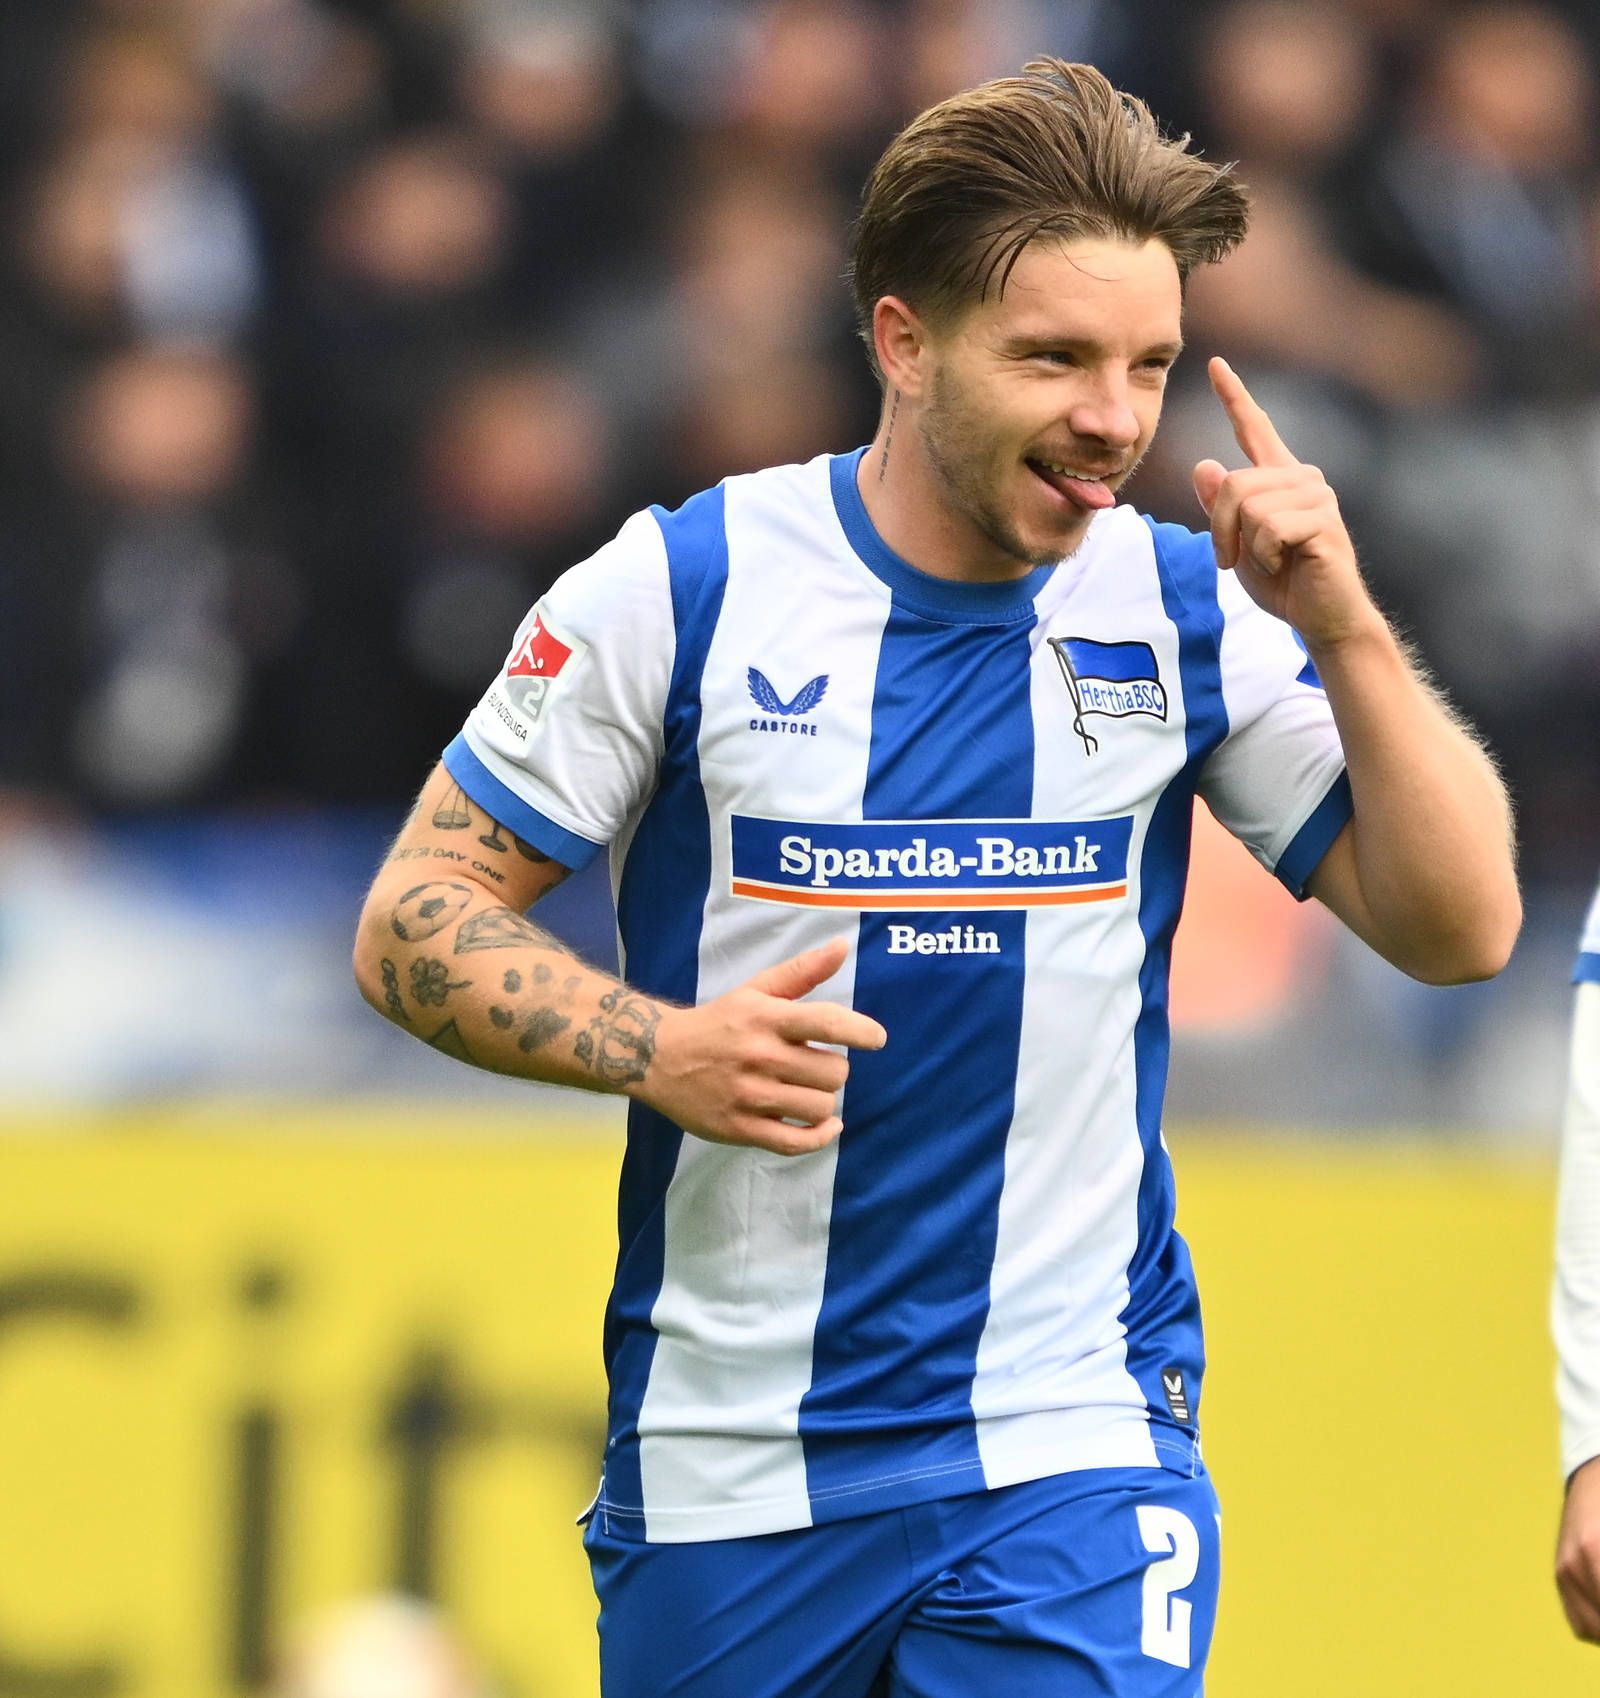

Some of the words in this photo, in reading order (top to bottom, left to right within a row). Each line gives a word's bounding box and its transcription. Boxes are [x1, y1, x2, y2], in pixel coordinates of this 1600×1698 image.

[1080, 682, 1135, 712] Hertha
[1132, 684, 1163, 711] BSC
[487, 692, 528, 742] BUNDESLIGA
[749, 719, 817, 737] CASTORE
[433, 847, 467, 862] DAY
[472, 861, 506, 884] ONE
[779, 835, 1102, 887] Sparda-Bank
[886, 925, 1001, 955] Berlin
[1135, 1504, 1200, 1669] 2
